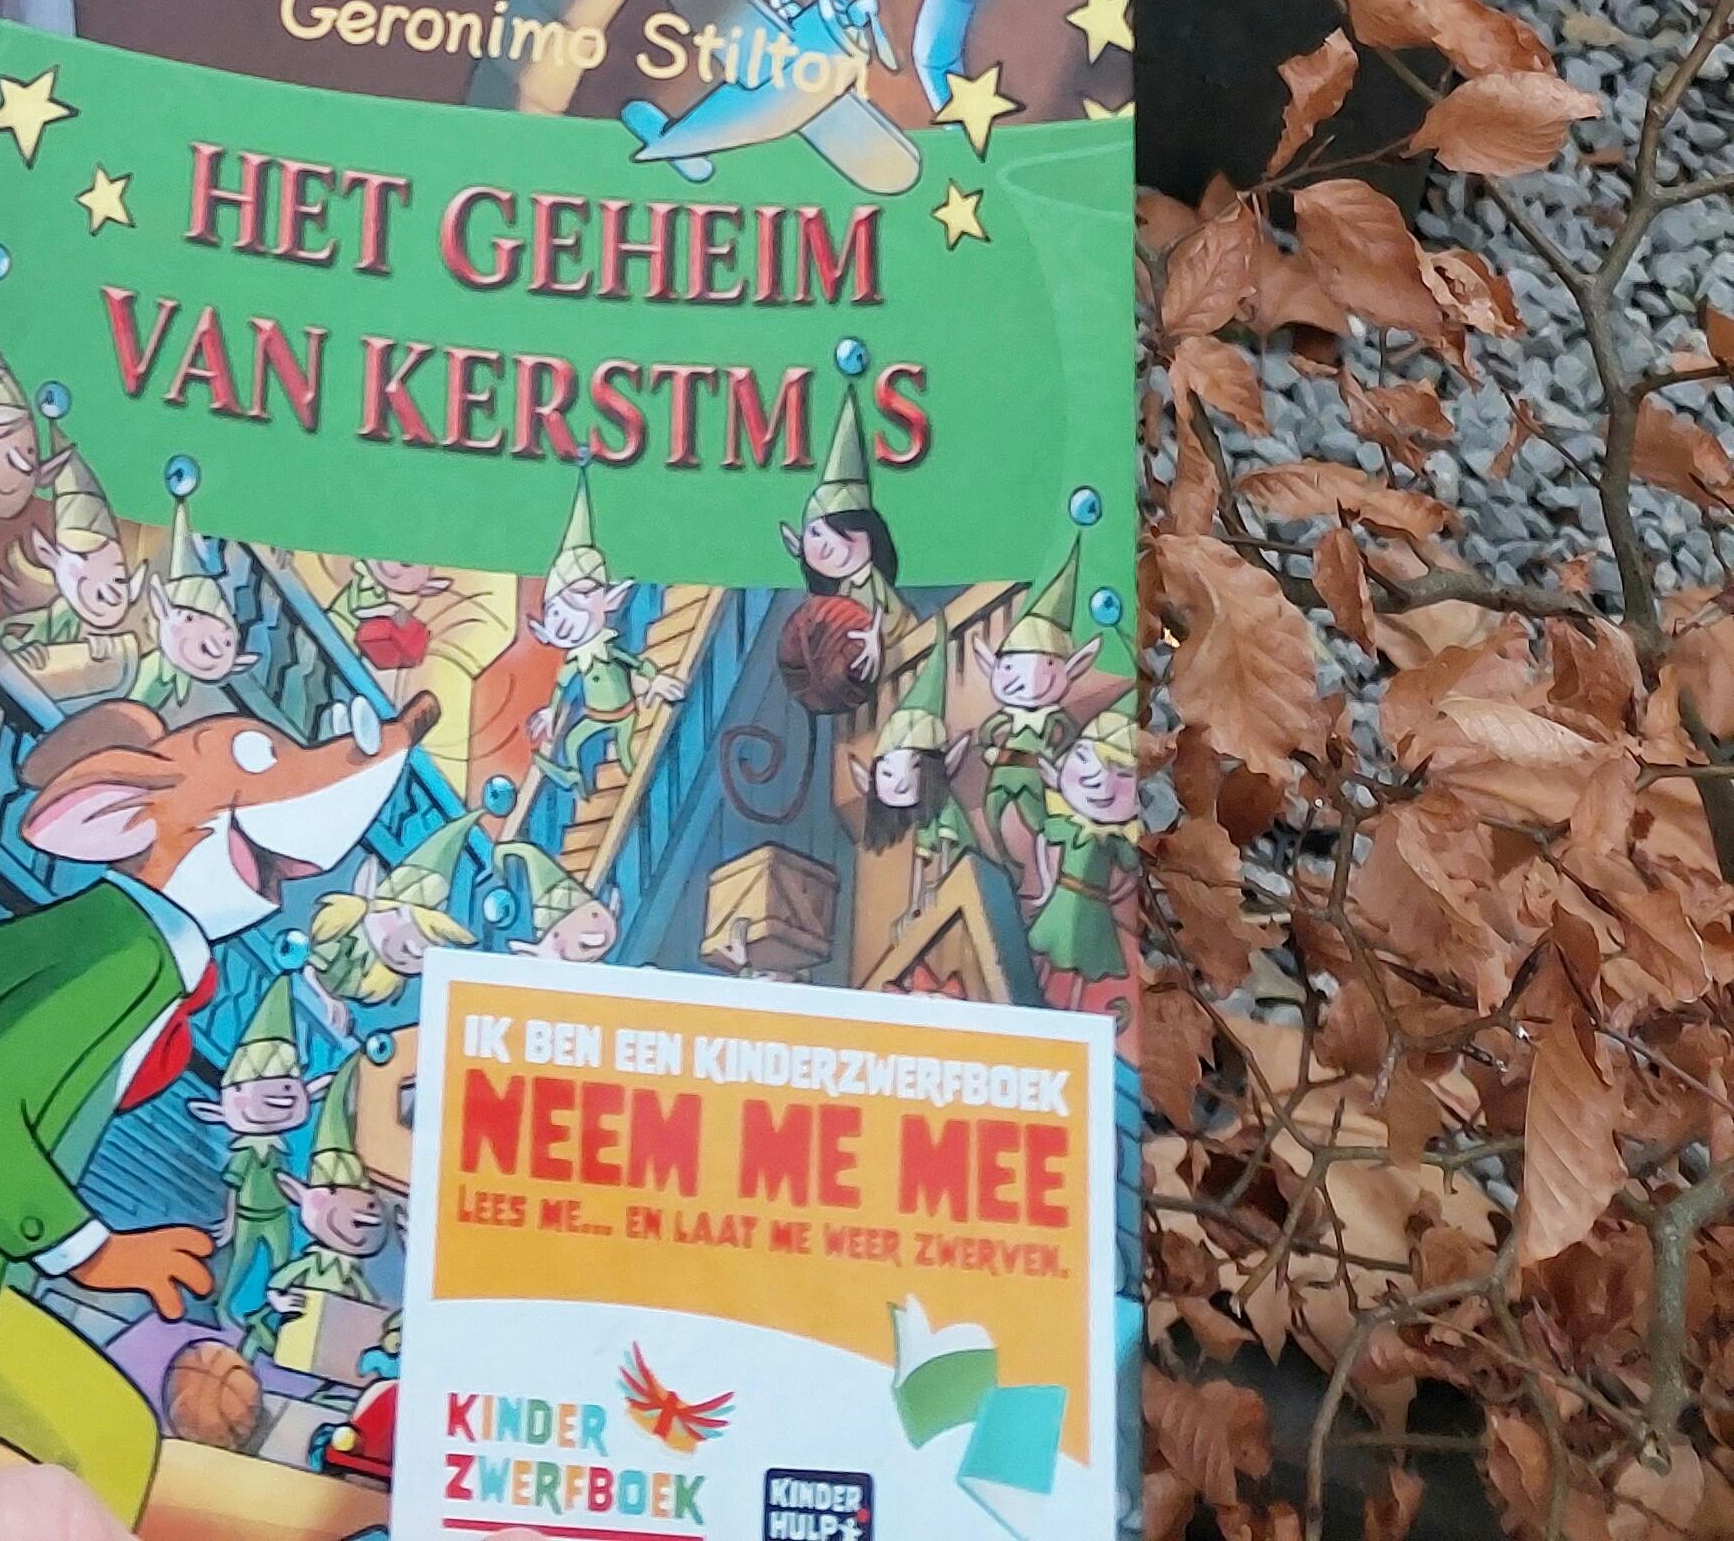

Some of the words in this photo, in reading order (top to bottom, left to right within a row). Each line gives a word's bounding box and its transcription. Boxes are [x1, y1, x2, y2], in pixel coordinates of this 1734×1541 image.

[634, 10, 876, 105] Stilton
[181, 138, 414, 277] HET
[439, 183, 887, 310] GEHEIM
[98, 283, 329, 432] VAN
[355, 330, 933, 473] KERSTMS
[462, 1013, 510, 1064] IK
[523, 1019, 603, 1068] BEN
[614, 1030, 682, 1076] EEN
[693, 1035, 1072, 1116] KINDERZWERFBOEK
[456, 1067, 704, 1198] NEEM
[735, 1096, 866, 1209] ME
[897, 1111, 1073, 1230] MEE
[456, 1186, 526, 1228] LEES
[535, 1200, 612, 1238] ME...
[625, 1205, 662, 1241] EN
[674, 1211, 758, 1250] LAAT
[768, 1219, 814, 1258] ME
[823, 1224, 904, 1268] WEER
[914, 1232, 1070, 1280] ZWERVEN.
[445, 1391, 609, 1456] KINDER
[442, 1453, 706, 1526] ZWERFBOEK
[769, 1477, 863, 1513] KINDER
[769, 1511, 839, 1541] HULP
